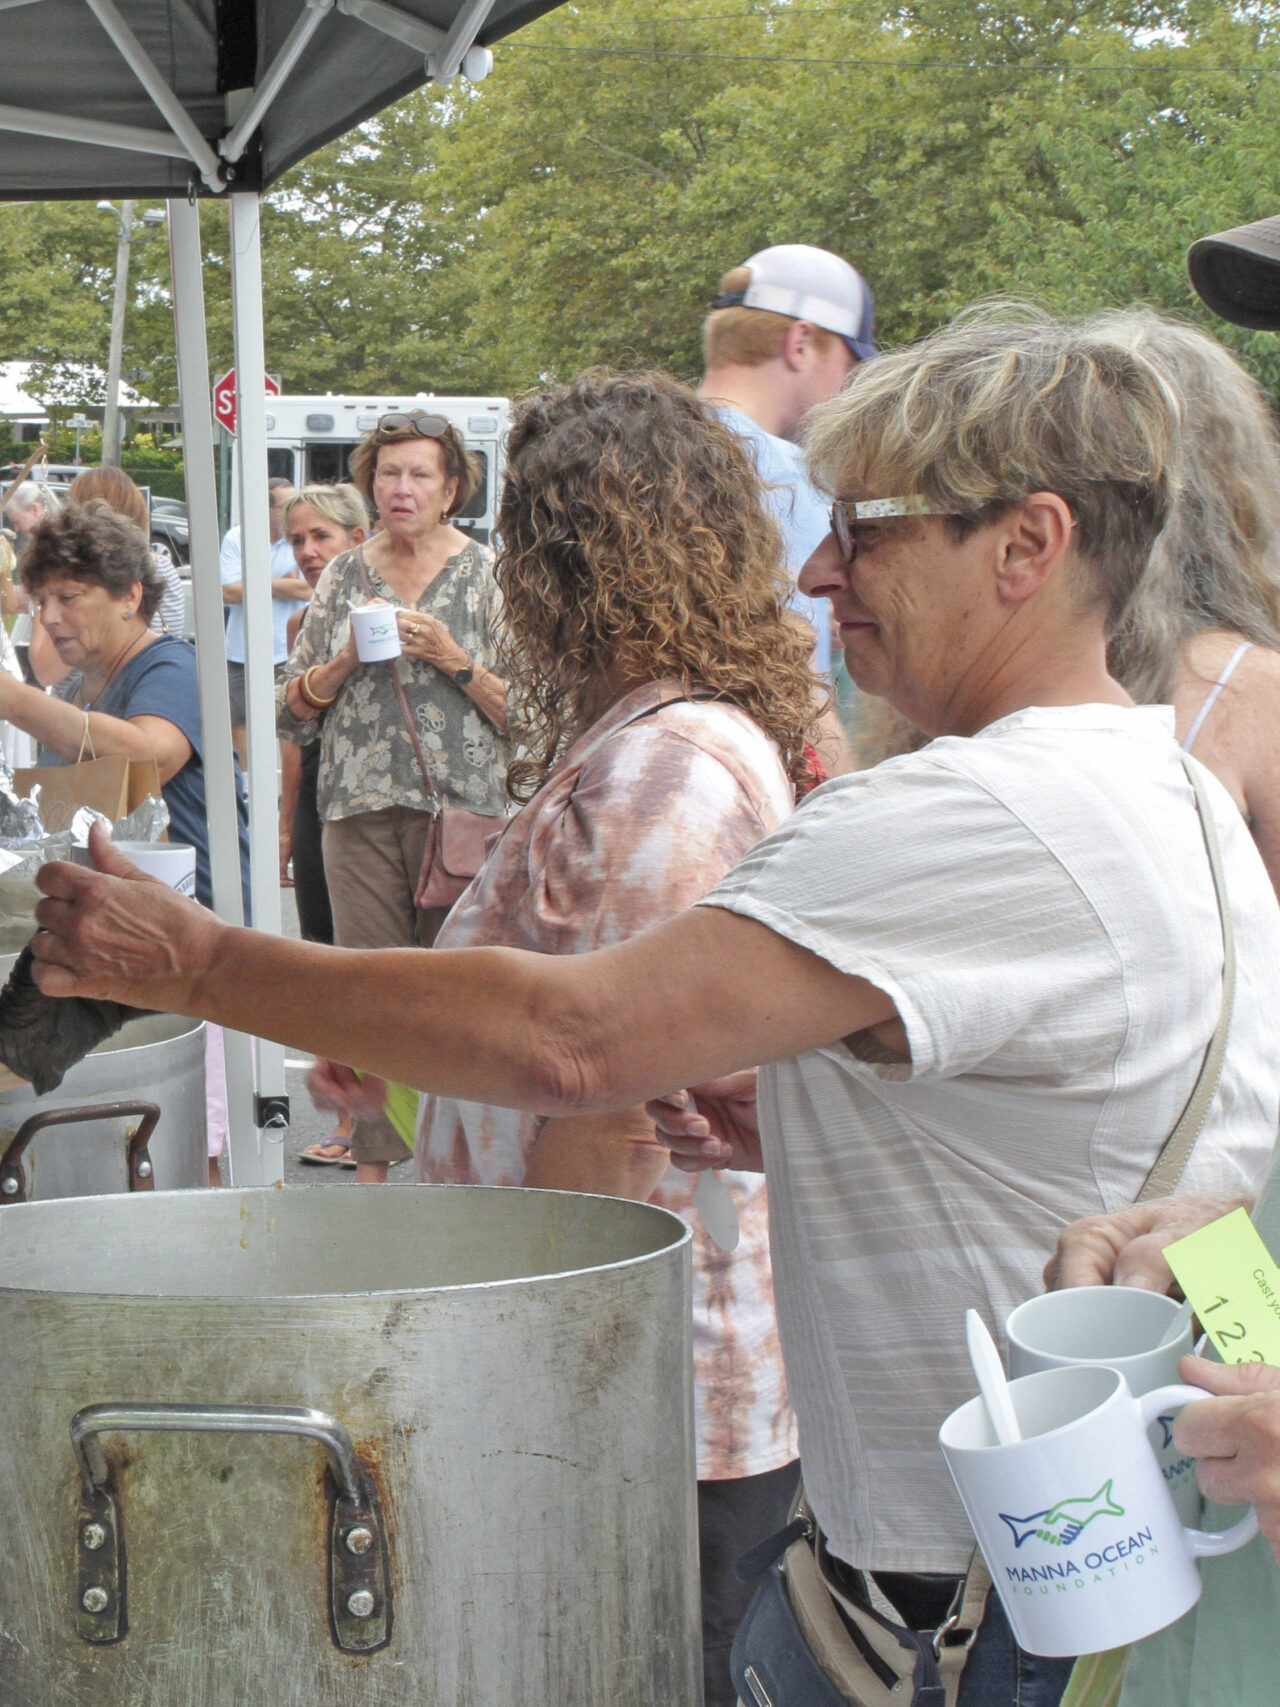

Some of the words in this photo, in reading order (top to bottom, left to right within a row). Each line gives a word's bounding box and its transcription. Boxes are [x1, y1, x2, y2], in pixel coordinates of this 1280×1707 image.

[1253, 1269, 1274, 1299] Cast
[1267, 1303, 1280, 1320] yo
[1215, 1322, 1246, 1347] 2
[1006, 1560, 1081, 1582] MANNA
[1084, 1526, 1153, 1570] OCEAN
[1012, 1545, 1159, 1596] FOUNDATION
